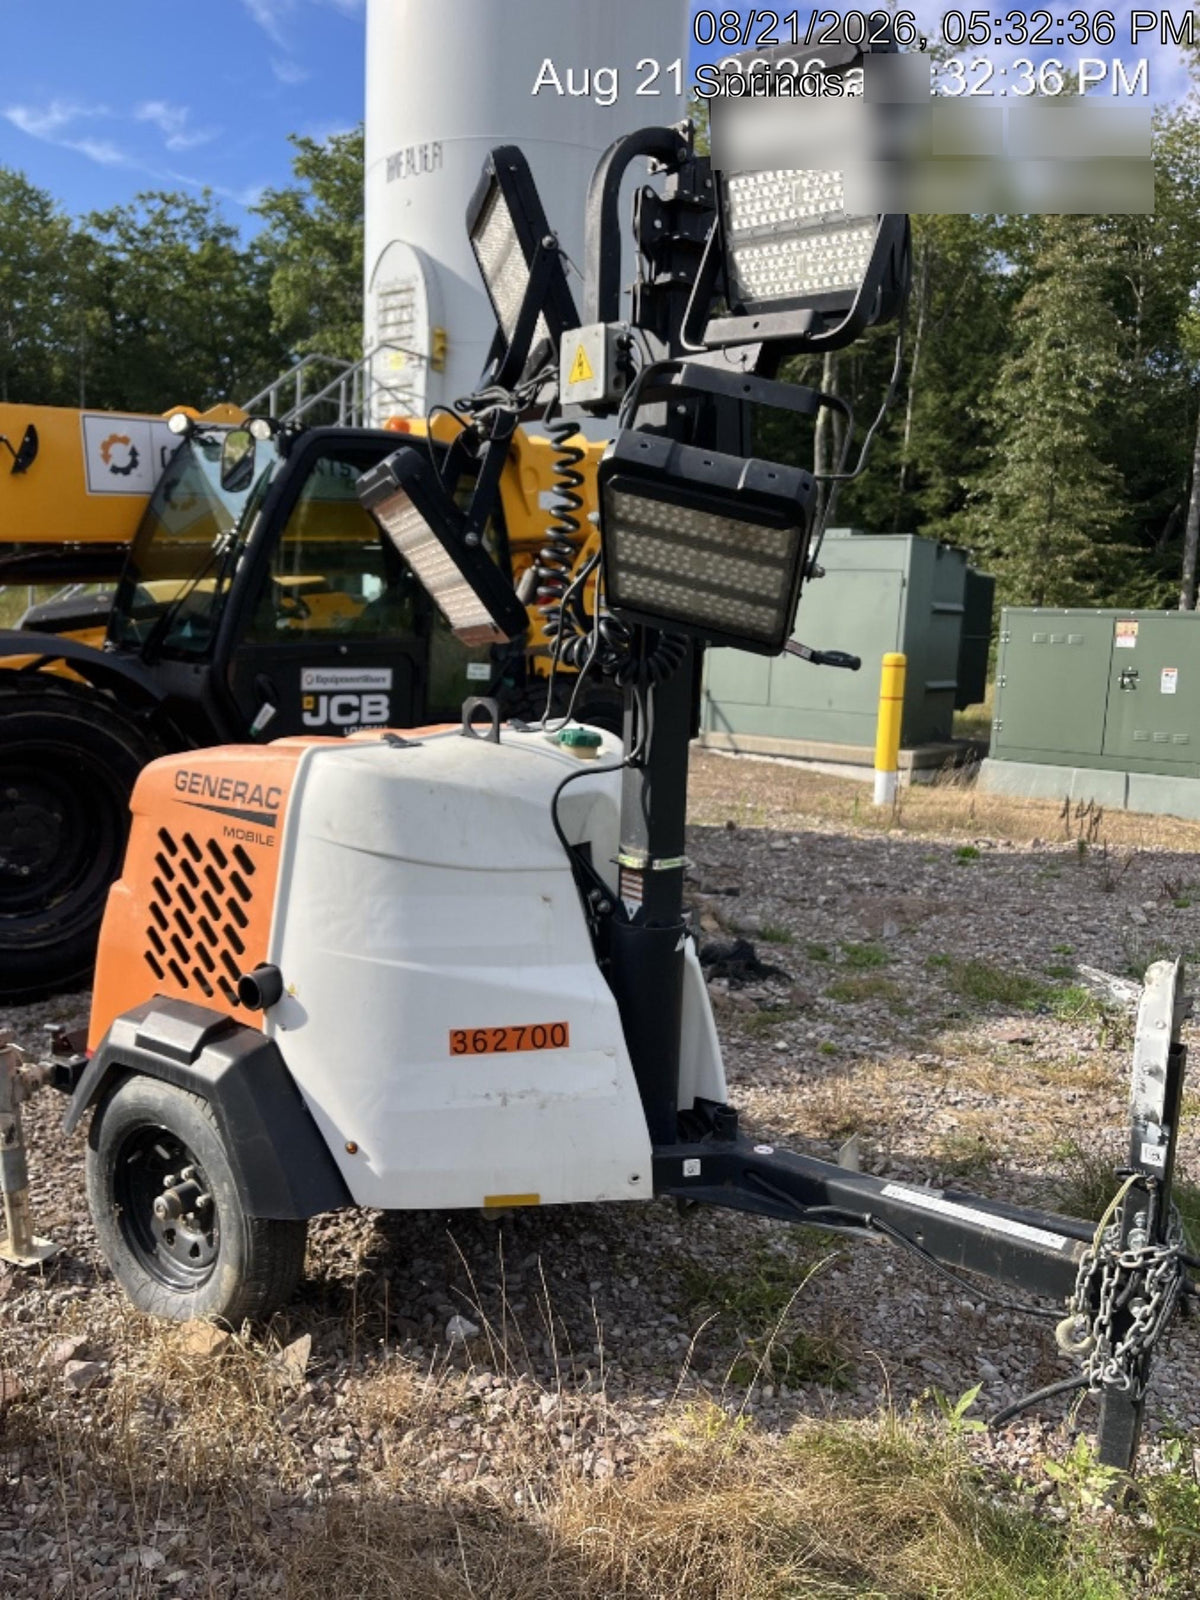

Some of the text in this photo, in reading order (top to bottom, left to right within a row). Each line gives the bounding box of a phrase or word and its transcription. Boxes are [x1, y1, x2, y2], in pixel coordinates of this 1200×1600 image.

[302, 694, 390, 726] JCB
[174, 769, 282, 810] GENERAC
[222, 825, 275, 847] MOBILE
[452, 1023, 567, 1054] 362700
